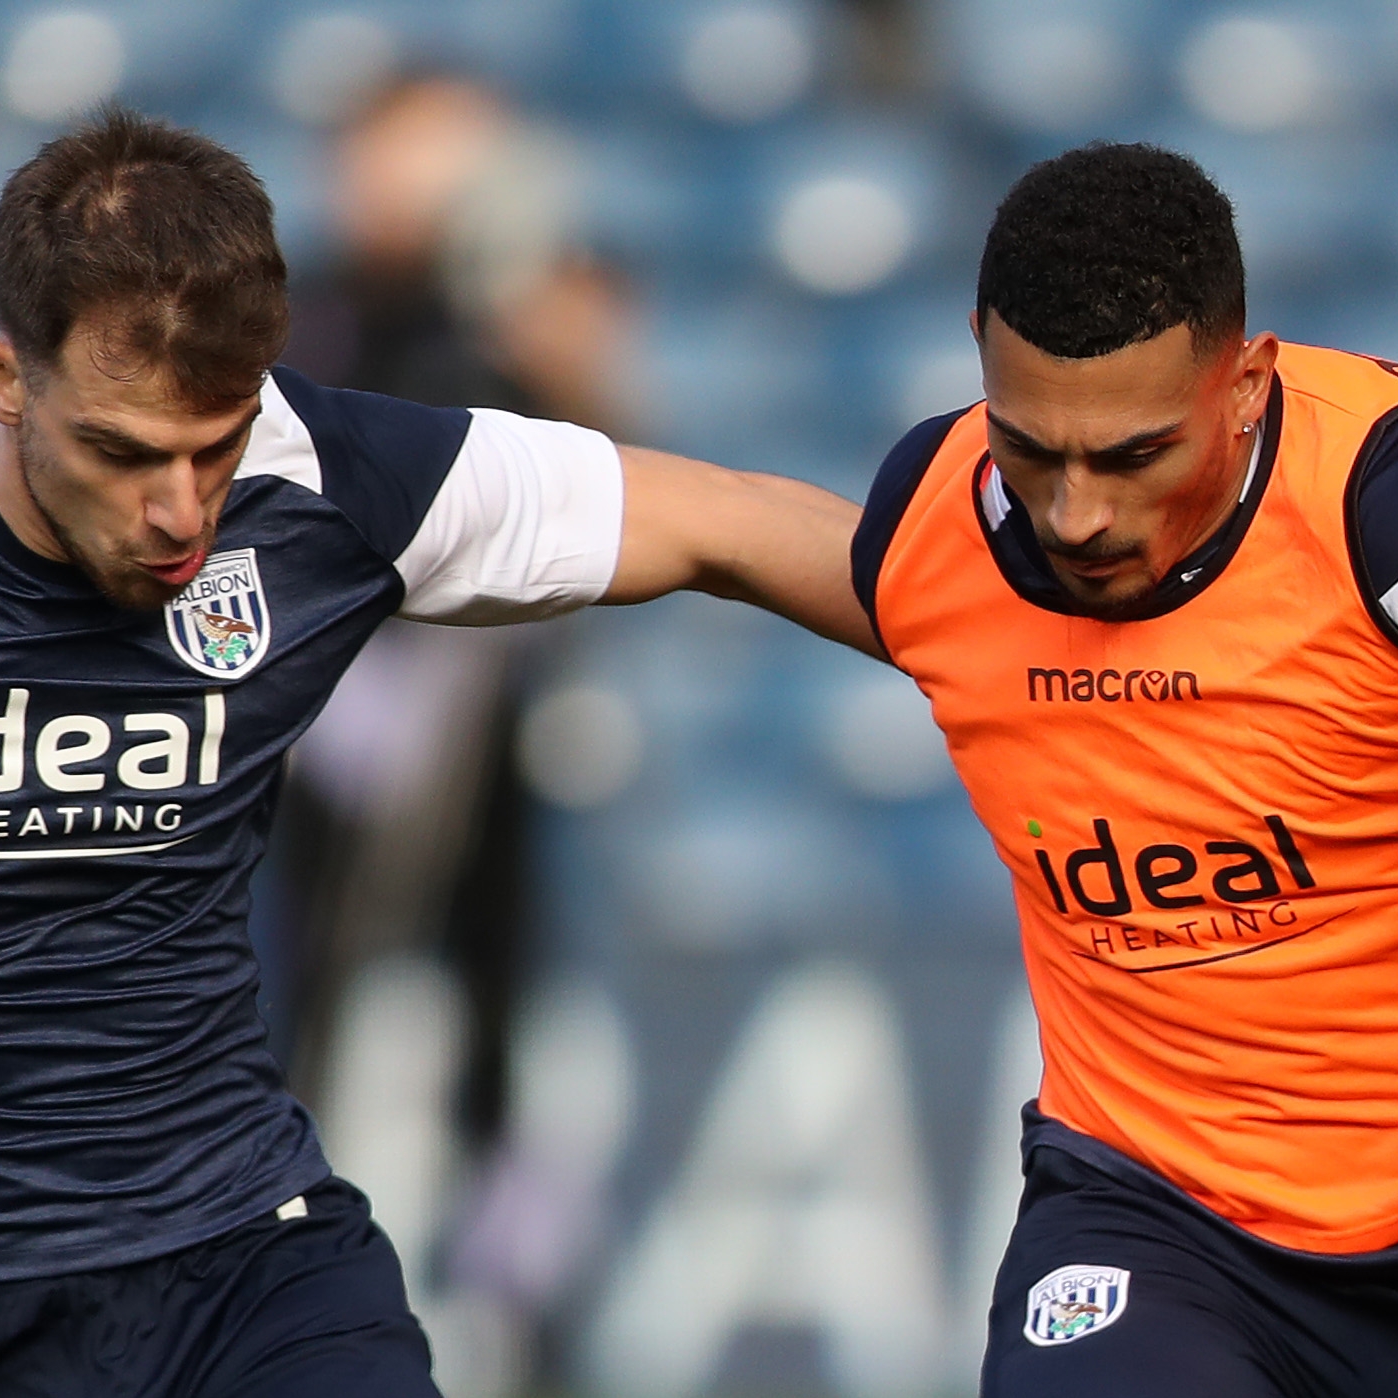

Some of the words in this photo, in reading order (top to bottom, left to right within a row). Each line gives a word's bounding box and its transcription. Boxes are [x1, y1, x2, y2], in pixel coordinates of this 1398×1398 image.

[174, 571, 250, 607] ALBION
[1026, 667, 1203, 703] macron
[1026, 814, 1317, 918] ideal
[1090, 900, 1300, 956] HEATING
[1037, 1273, 1115, 1306] ALBION
